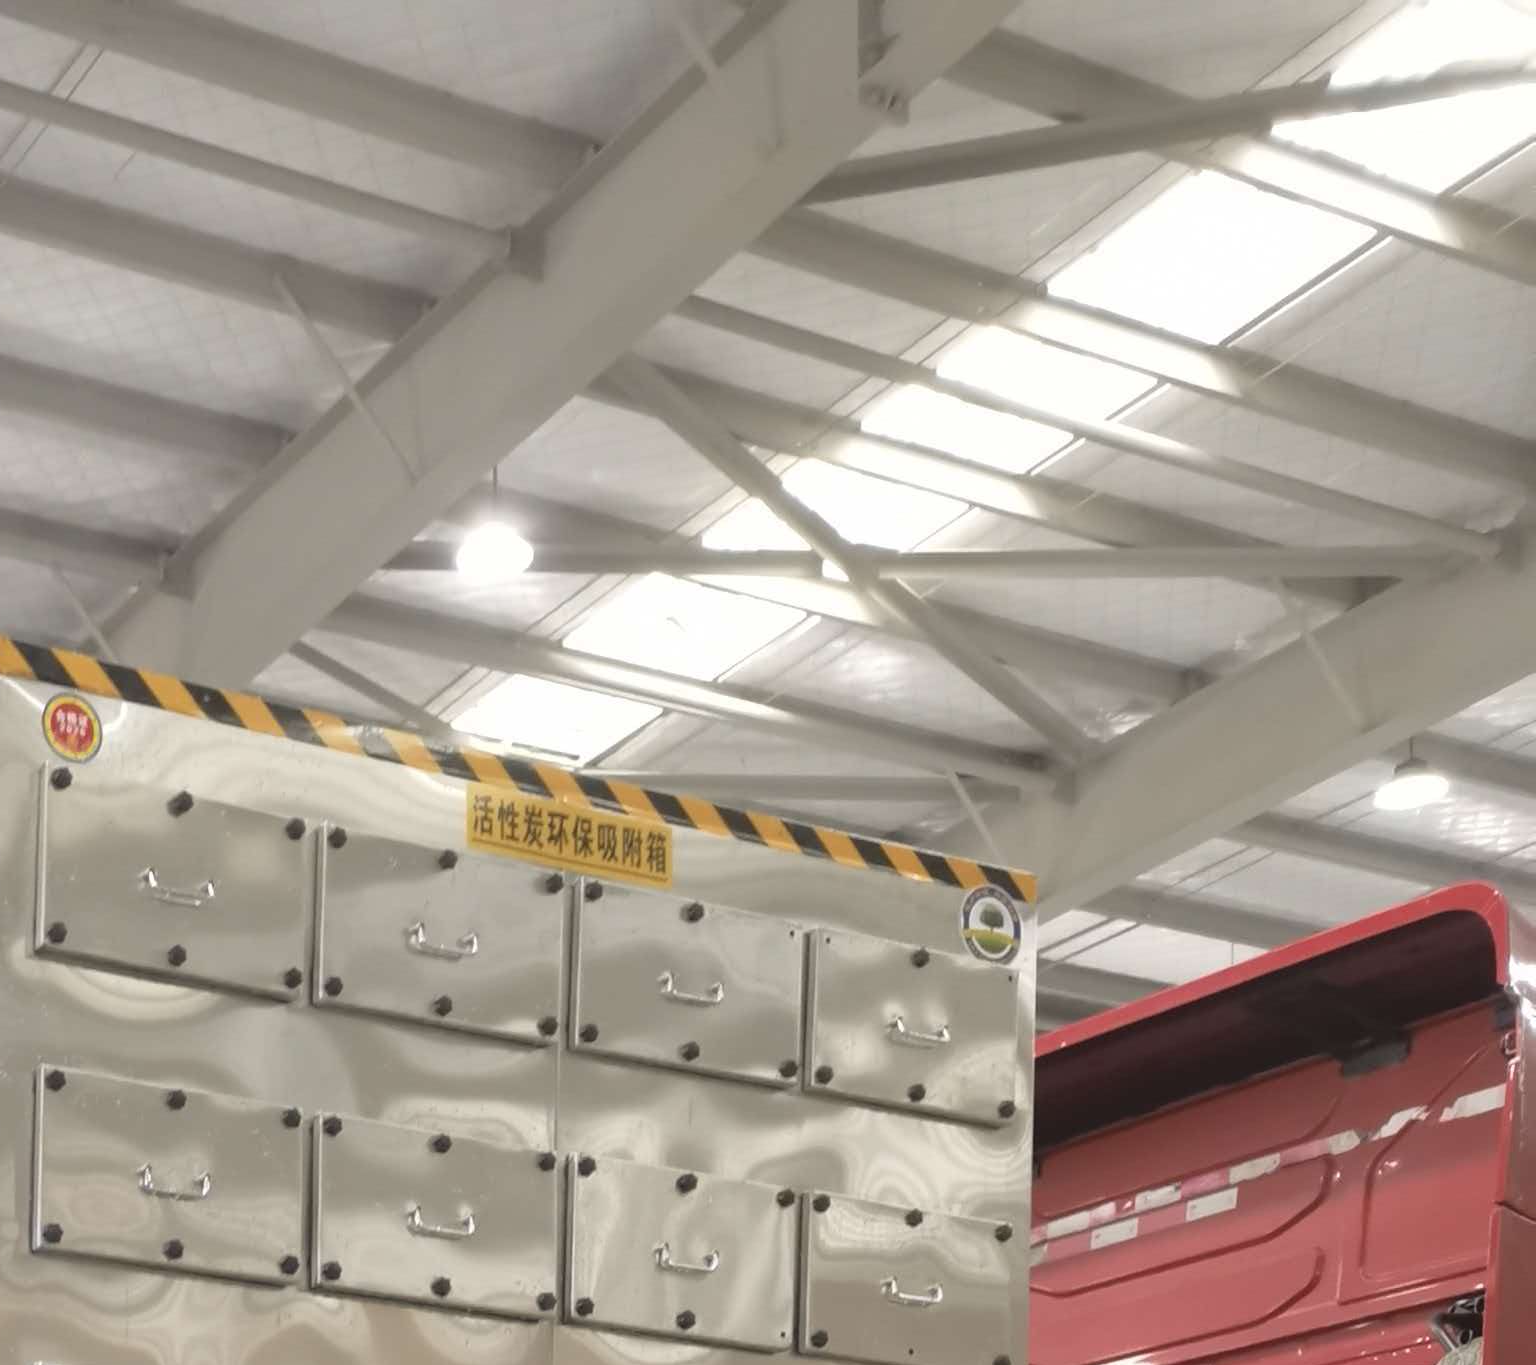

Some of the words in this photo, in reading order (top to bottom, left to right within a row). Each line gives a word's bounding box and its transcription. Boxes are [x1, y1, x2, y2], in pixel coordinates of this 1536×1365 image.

[473, 794, 666, 874] 活性炭环保吸附箱
